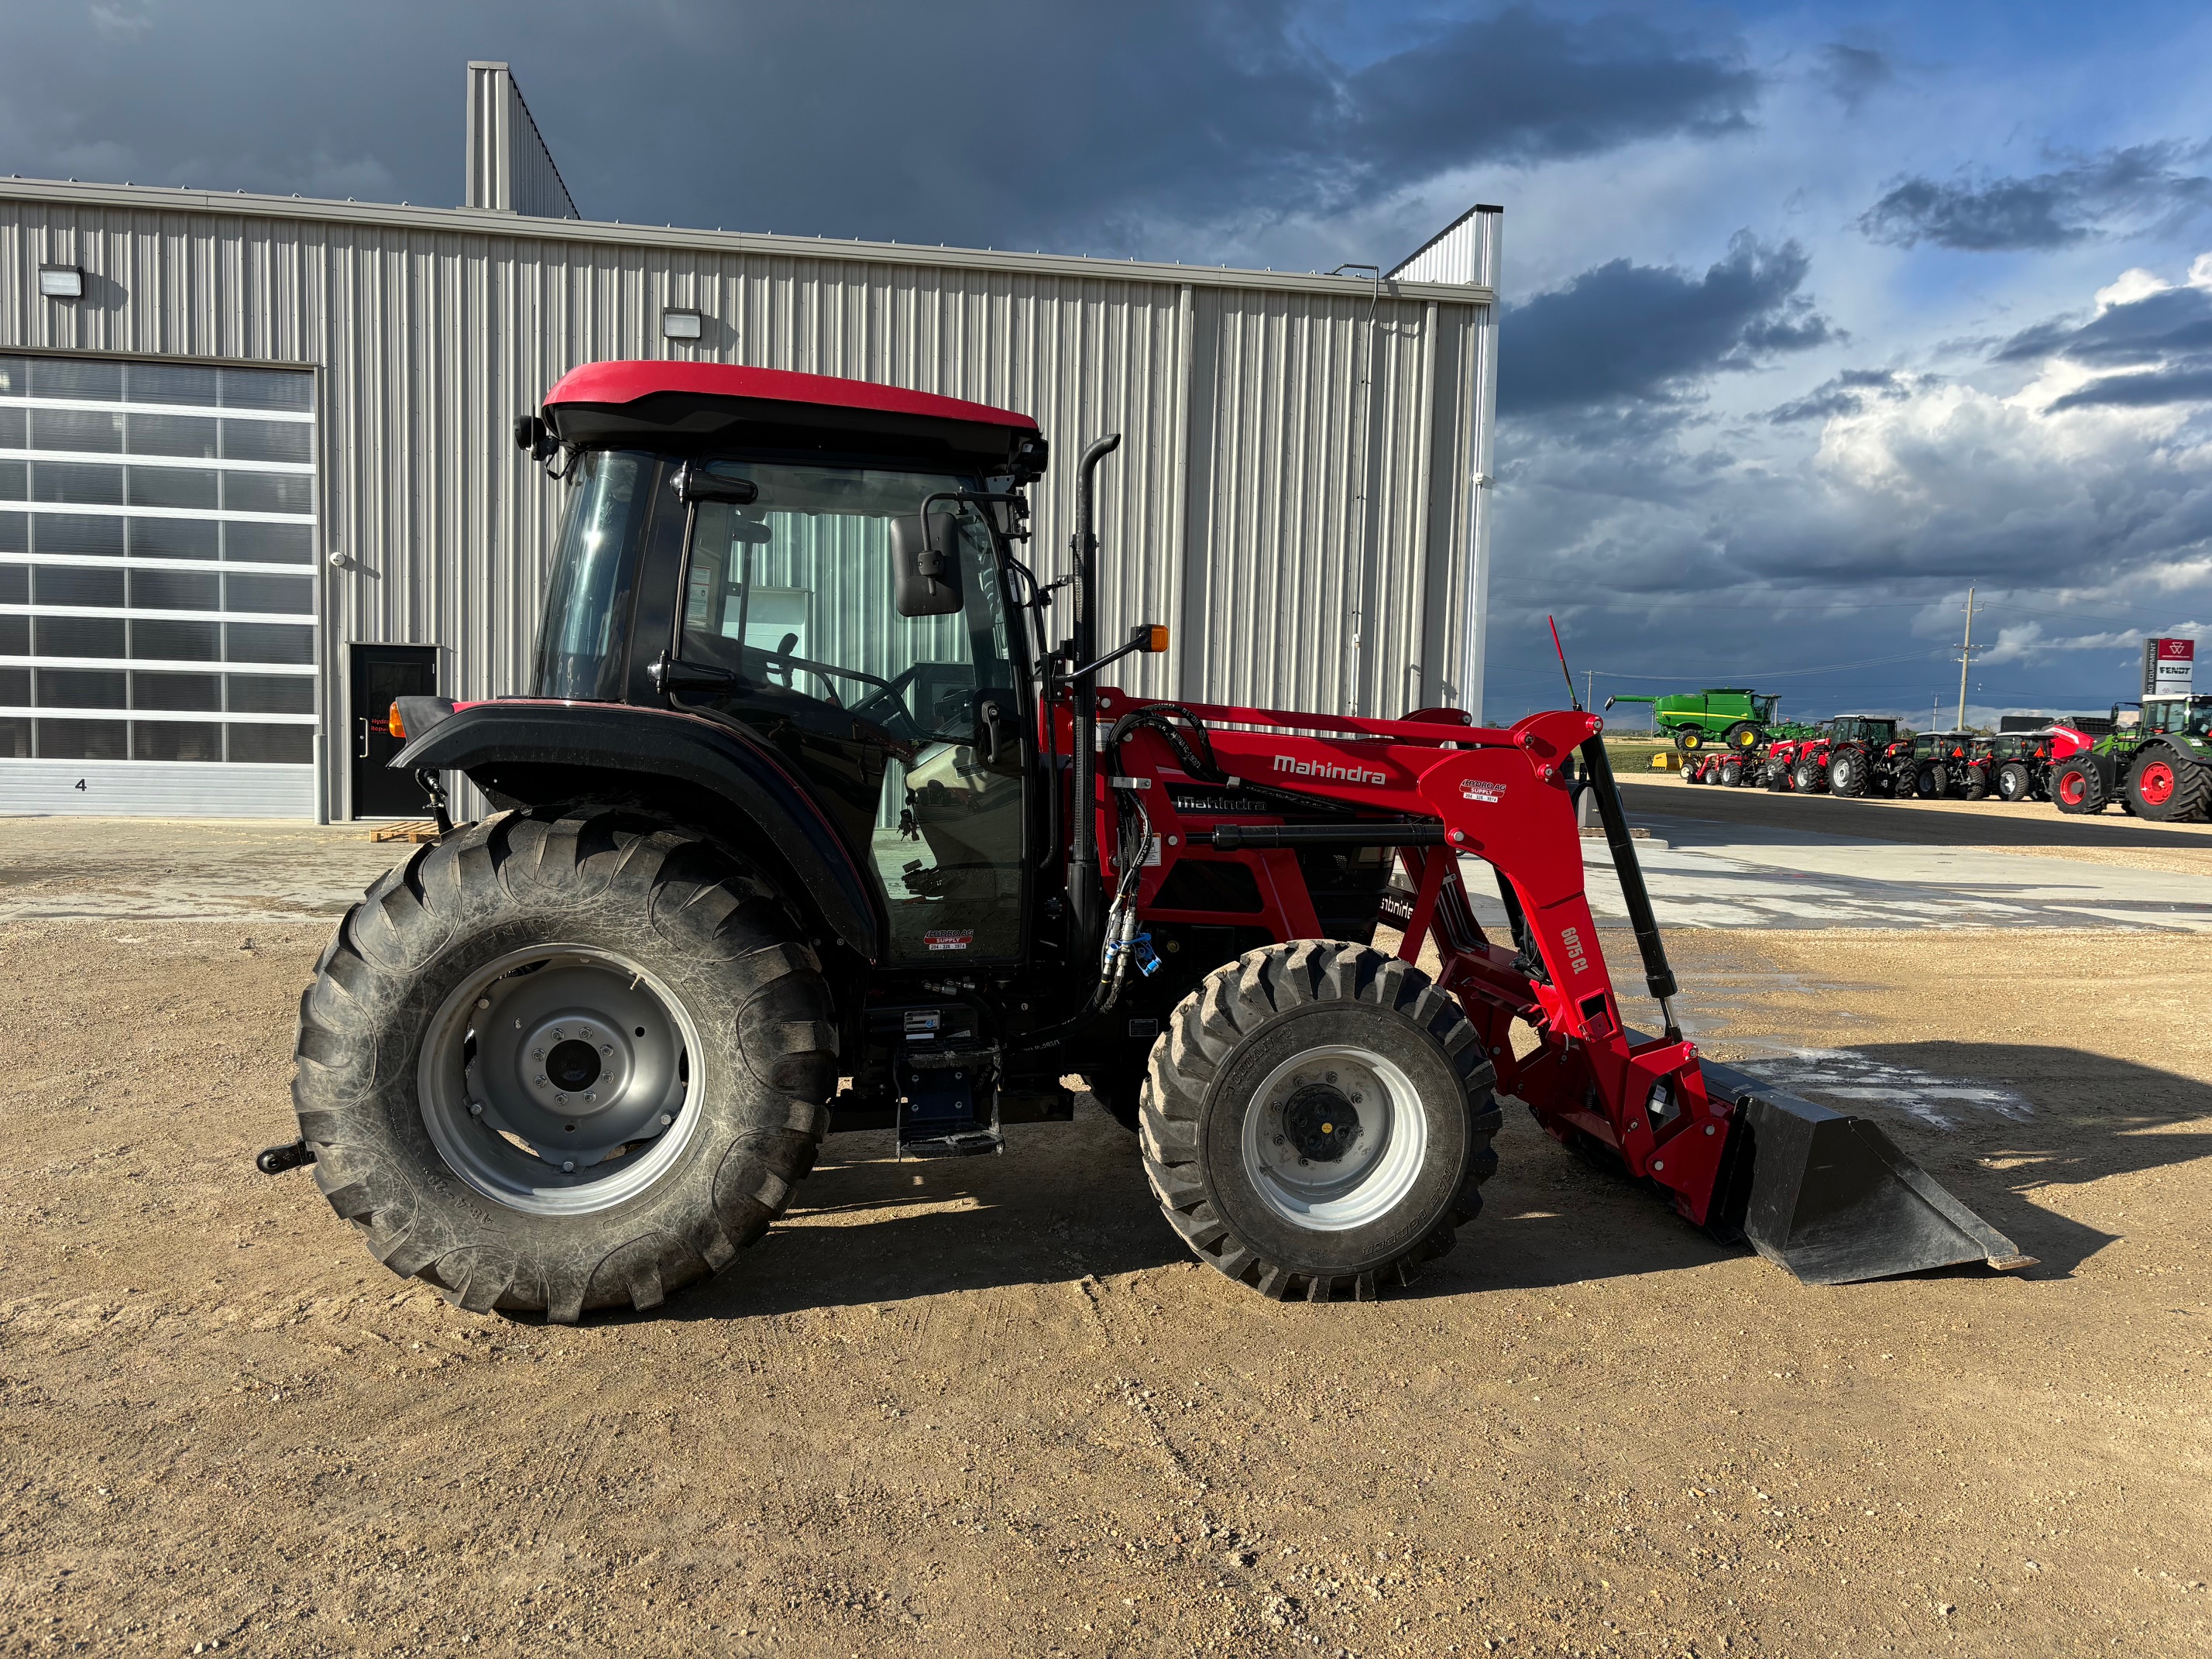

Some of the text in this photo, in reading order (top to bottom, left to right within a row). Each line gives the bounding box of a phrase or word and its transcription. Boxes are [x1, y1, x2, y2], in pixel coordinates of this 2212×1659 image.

[2148, 642, 2156, 682] EQUIPMENT
[75, 778, 88, 792] 4
[1273, 755, 1386, 785] Mahindra
[1462, 779, 1494, 789] HYDRO
[1177, 795, 1267, 811] Mahindra
[1561, 927, 1589, 975] 6075 CL
[1230, 1036, 1275, 1084] TITAN
[1362, 1157, 1456, 1256] TRAC LOADER
